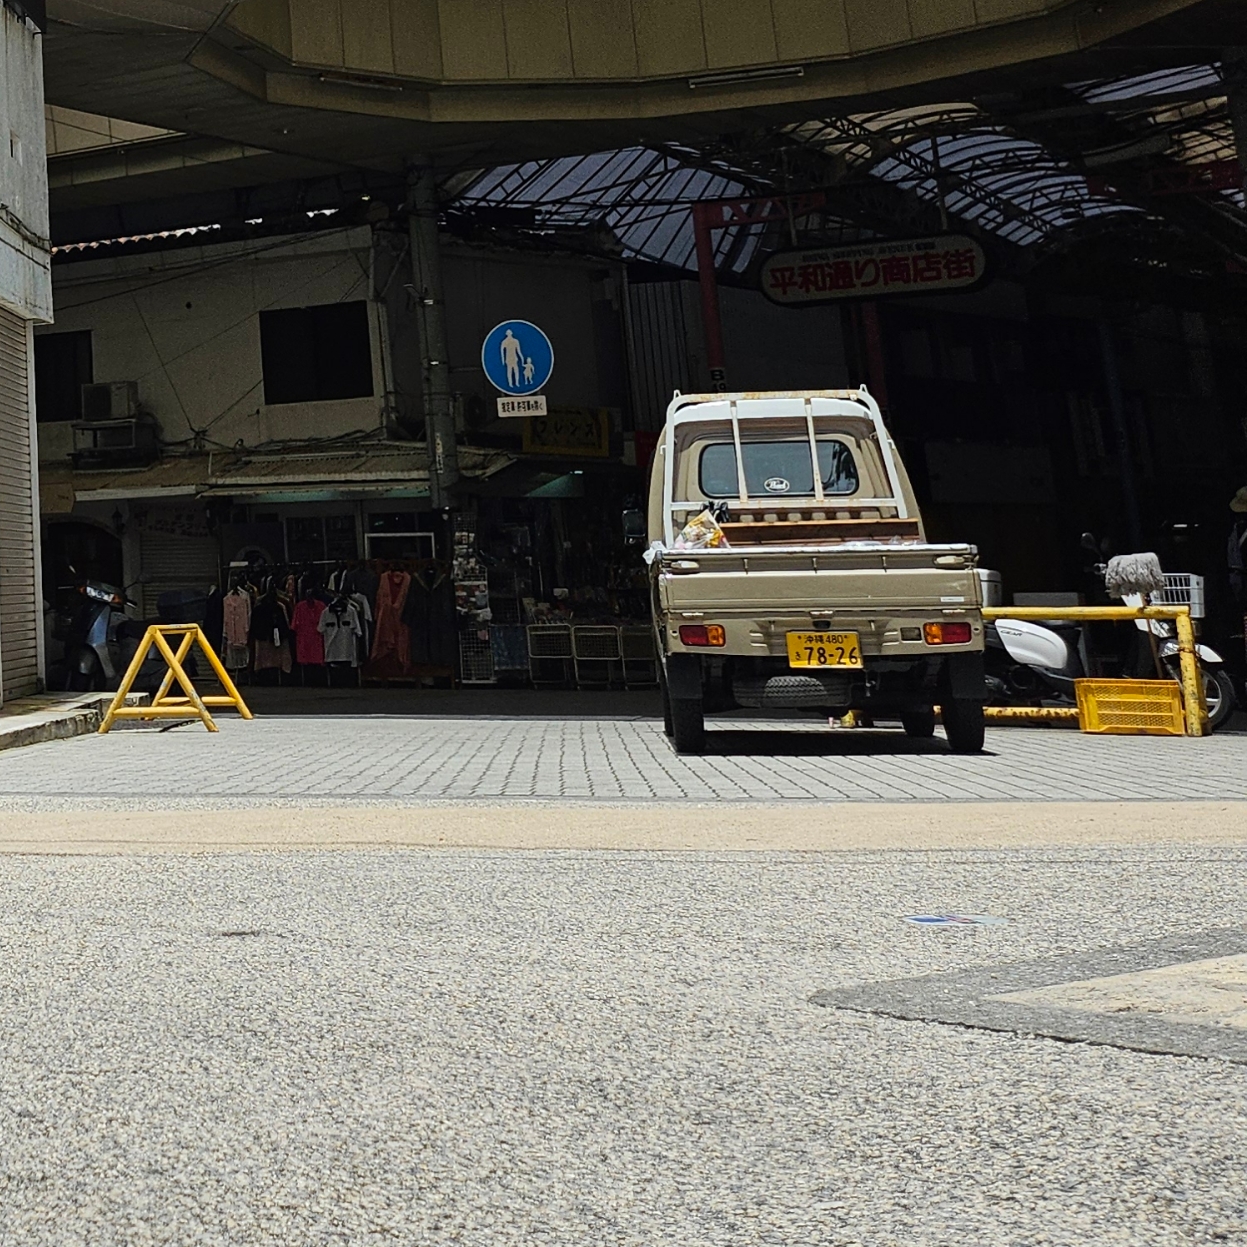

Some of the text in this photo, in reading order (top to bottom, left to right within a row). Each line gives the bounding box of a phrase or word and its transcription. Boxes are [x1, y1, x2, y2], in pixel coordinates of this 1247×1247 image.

[769, 248, 976, 295] 平和通り商店街
[803, 645, 859, 666] 78-26
